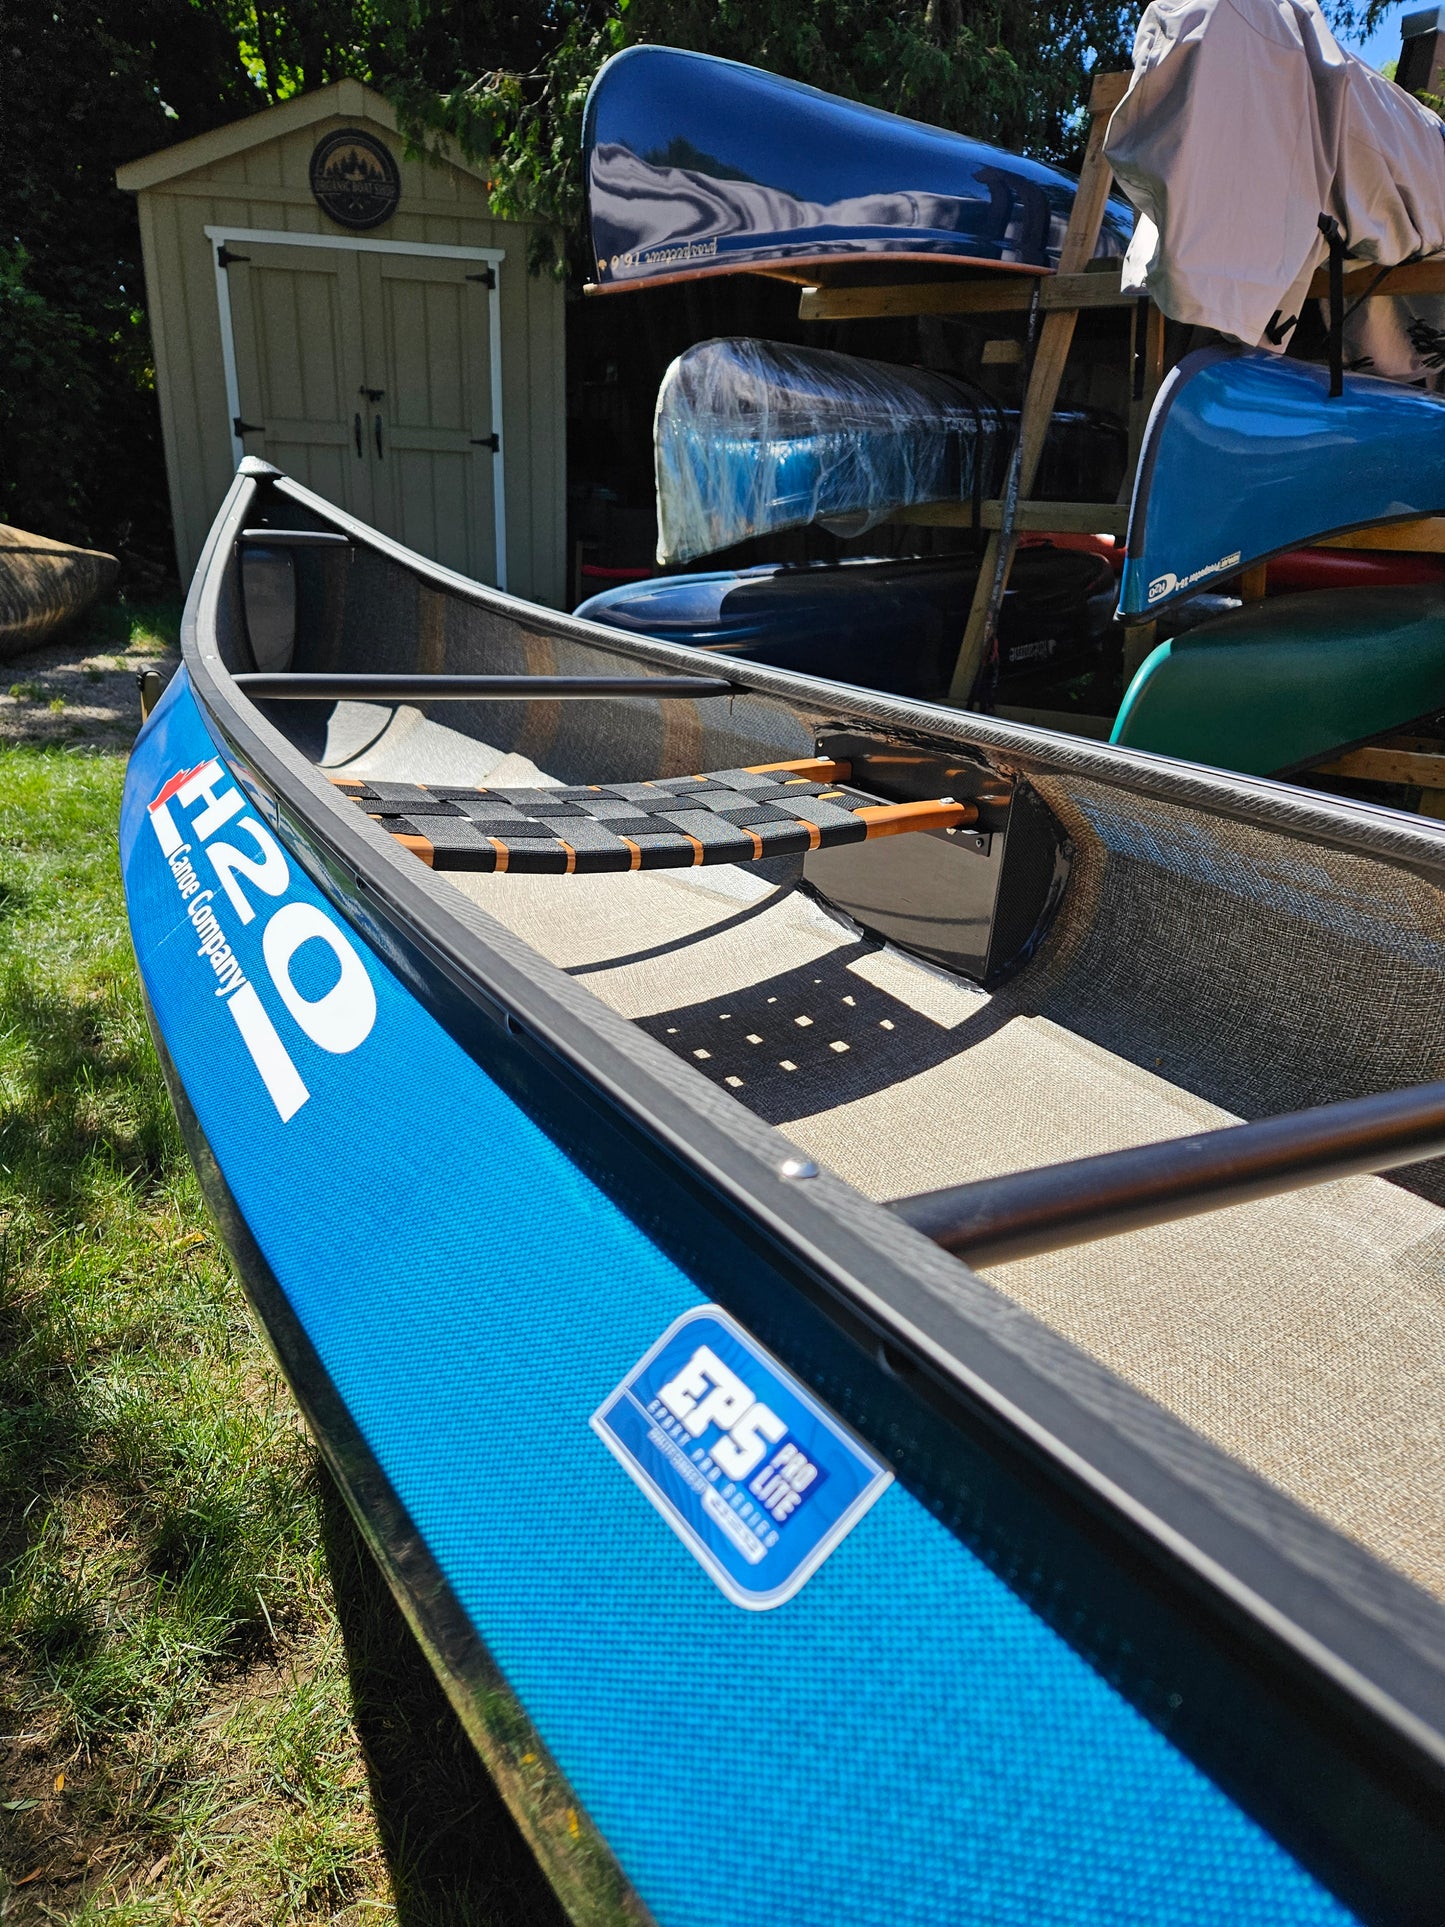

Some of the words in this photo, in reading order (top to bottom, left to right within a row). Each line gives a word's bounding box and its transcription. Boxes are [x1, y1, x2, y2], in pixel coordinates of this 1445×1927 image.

[645, 236, 717, 264] prospecteur
[168, 843, 201, 899] Canoe
[186, 889, 247, 997] Company
[176, 757, 377, 1054] H2O
[646, 1400, 692, 1447] EPOXY
[722, 1482, 780, 1548] SERIES
[657, 1344, 789, 1481] EPS
[772, 1442, 818, 1492] PRO
[749, 1465, 802, 1522] LITE
